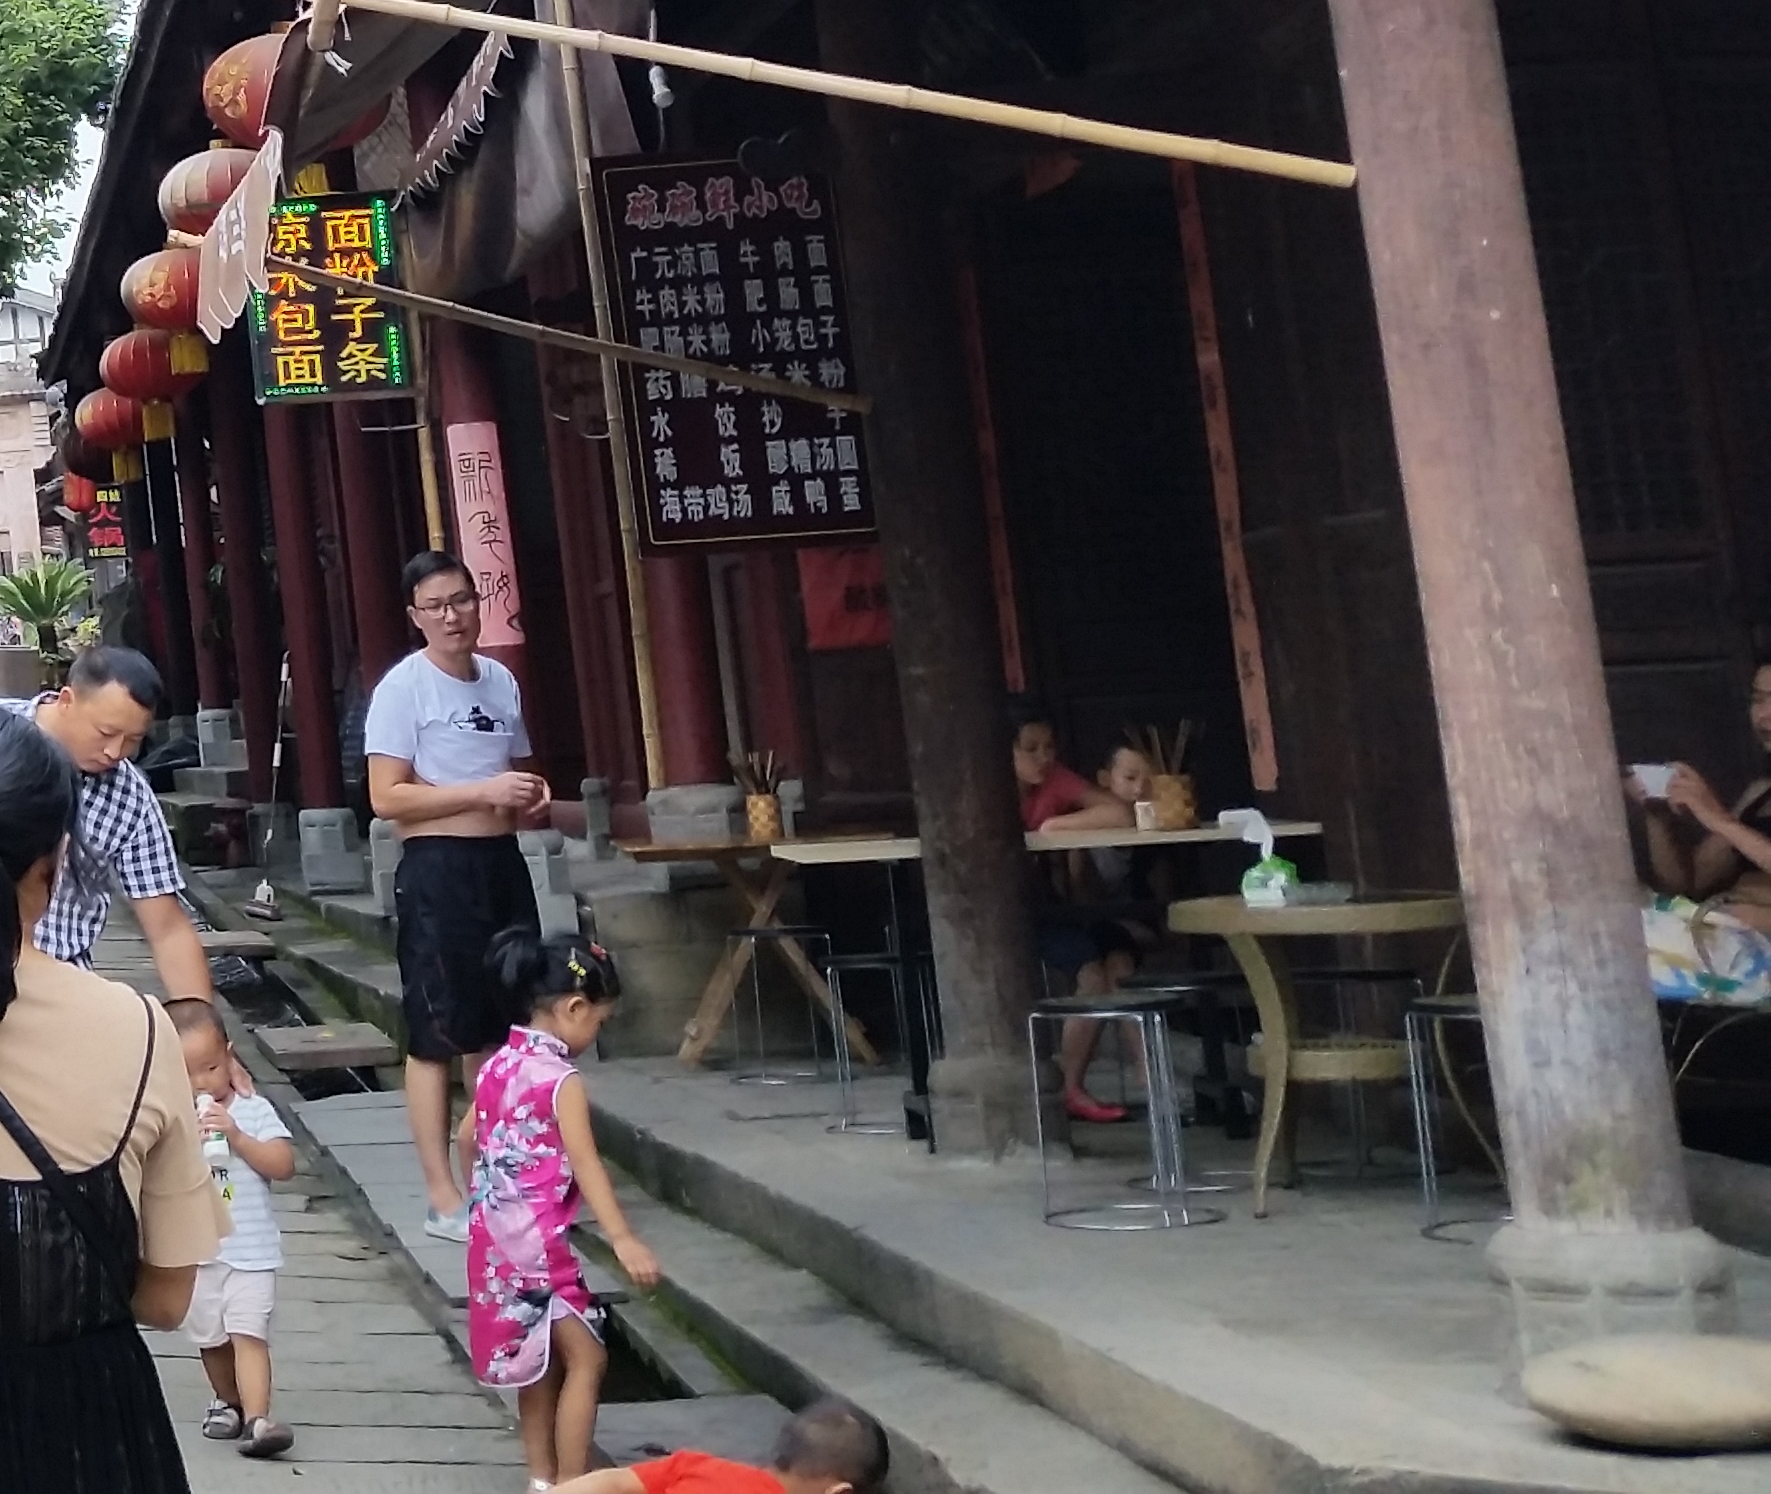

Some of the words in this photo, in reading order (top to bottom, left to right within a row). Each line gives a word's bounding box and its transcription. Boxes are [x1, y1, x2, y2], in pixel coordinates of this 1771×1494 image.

[630, 243, 720, 280] 广元凉面
[739, 235, 827, 274] 牛肉面
[635, 281, 725, 321] 牛肉米粉
[744, 275, 834, 313] 肥肠面
[751, 314, 840, 353] 小笼包子
[649, 402, 738, 442] 水饺
[654, 443, 743, 483] 稀饭
[659, 483, 753, 523] 海带鸡汤
[771, 476, 862, 516] 咸鸭蛋
[88, 502, 125, 547] 火锅
